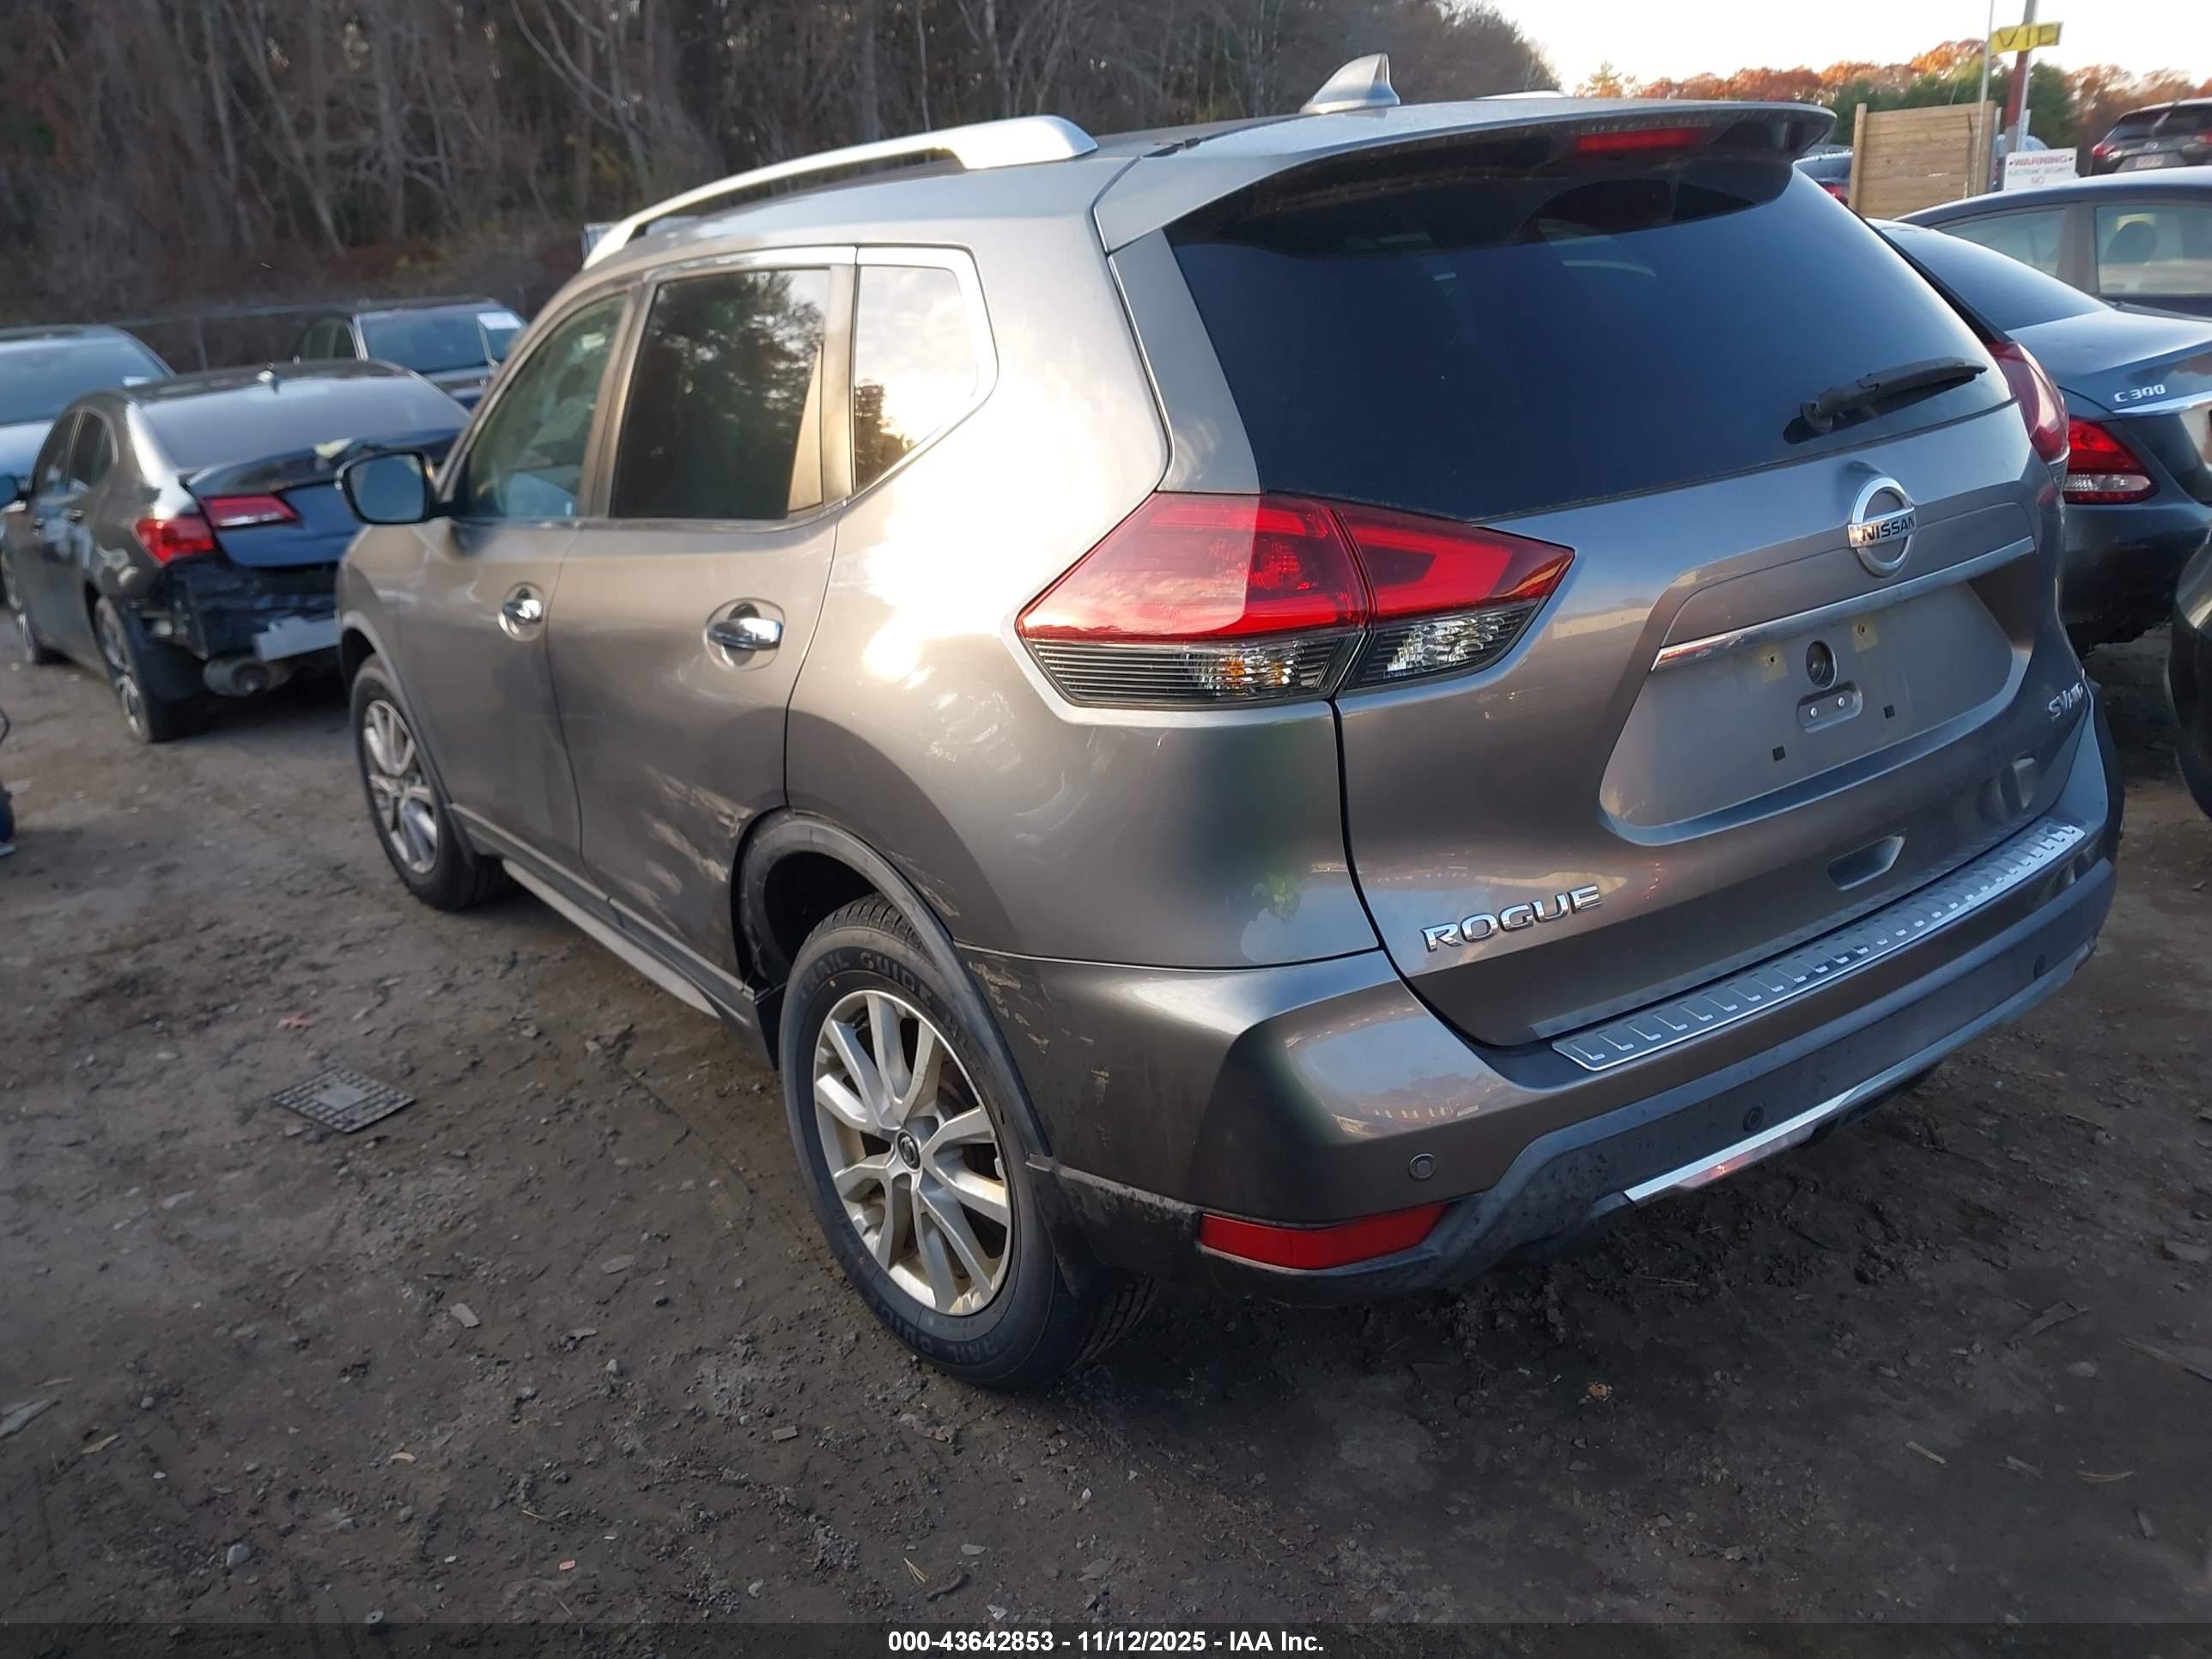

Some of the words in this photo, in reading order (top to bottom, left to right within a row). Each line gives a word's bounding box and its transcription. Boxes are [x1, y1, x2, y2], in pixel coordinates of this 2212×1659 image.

[2113, 392, 2129, 404] C
[2130, 384, 2166, 400] 300
[1862, 516, 1915, 542] NISSAN
[1420, 884, 1603, 952] ROGUE
